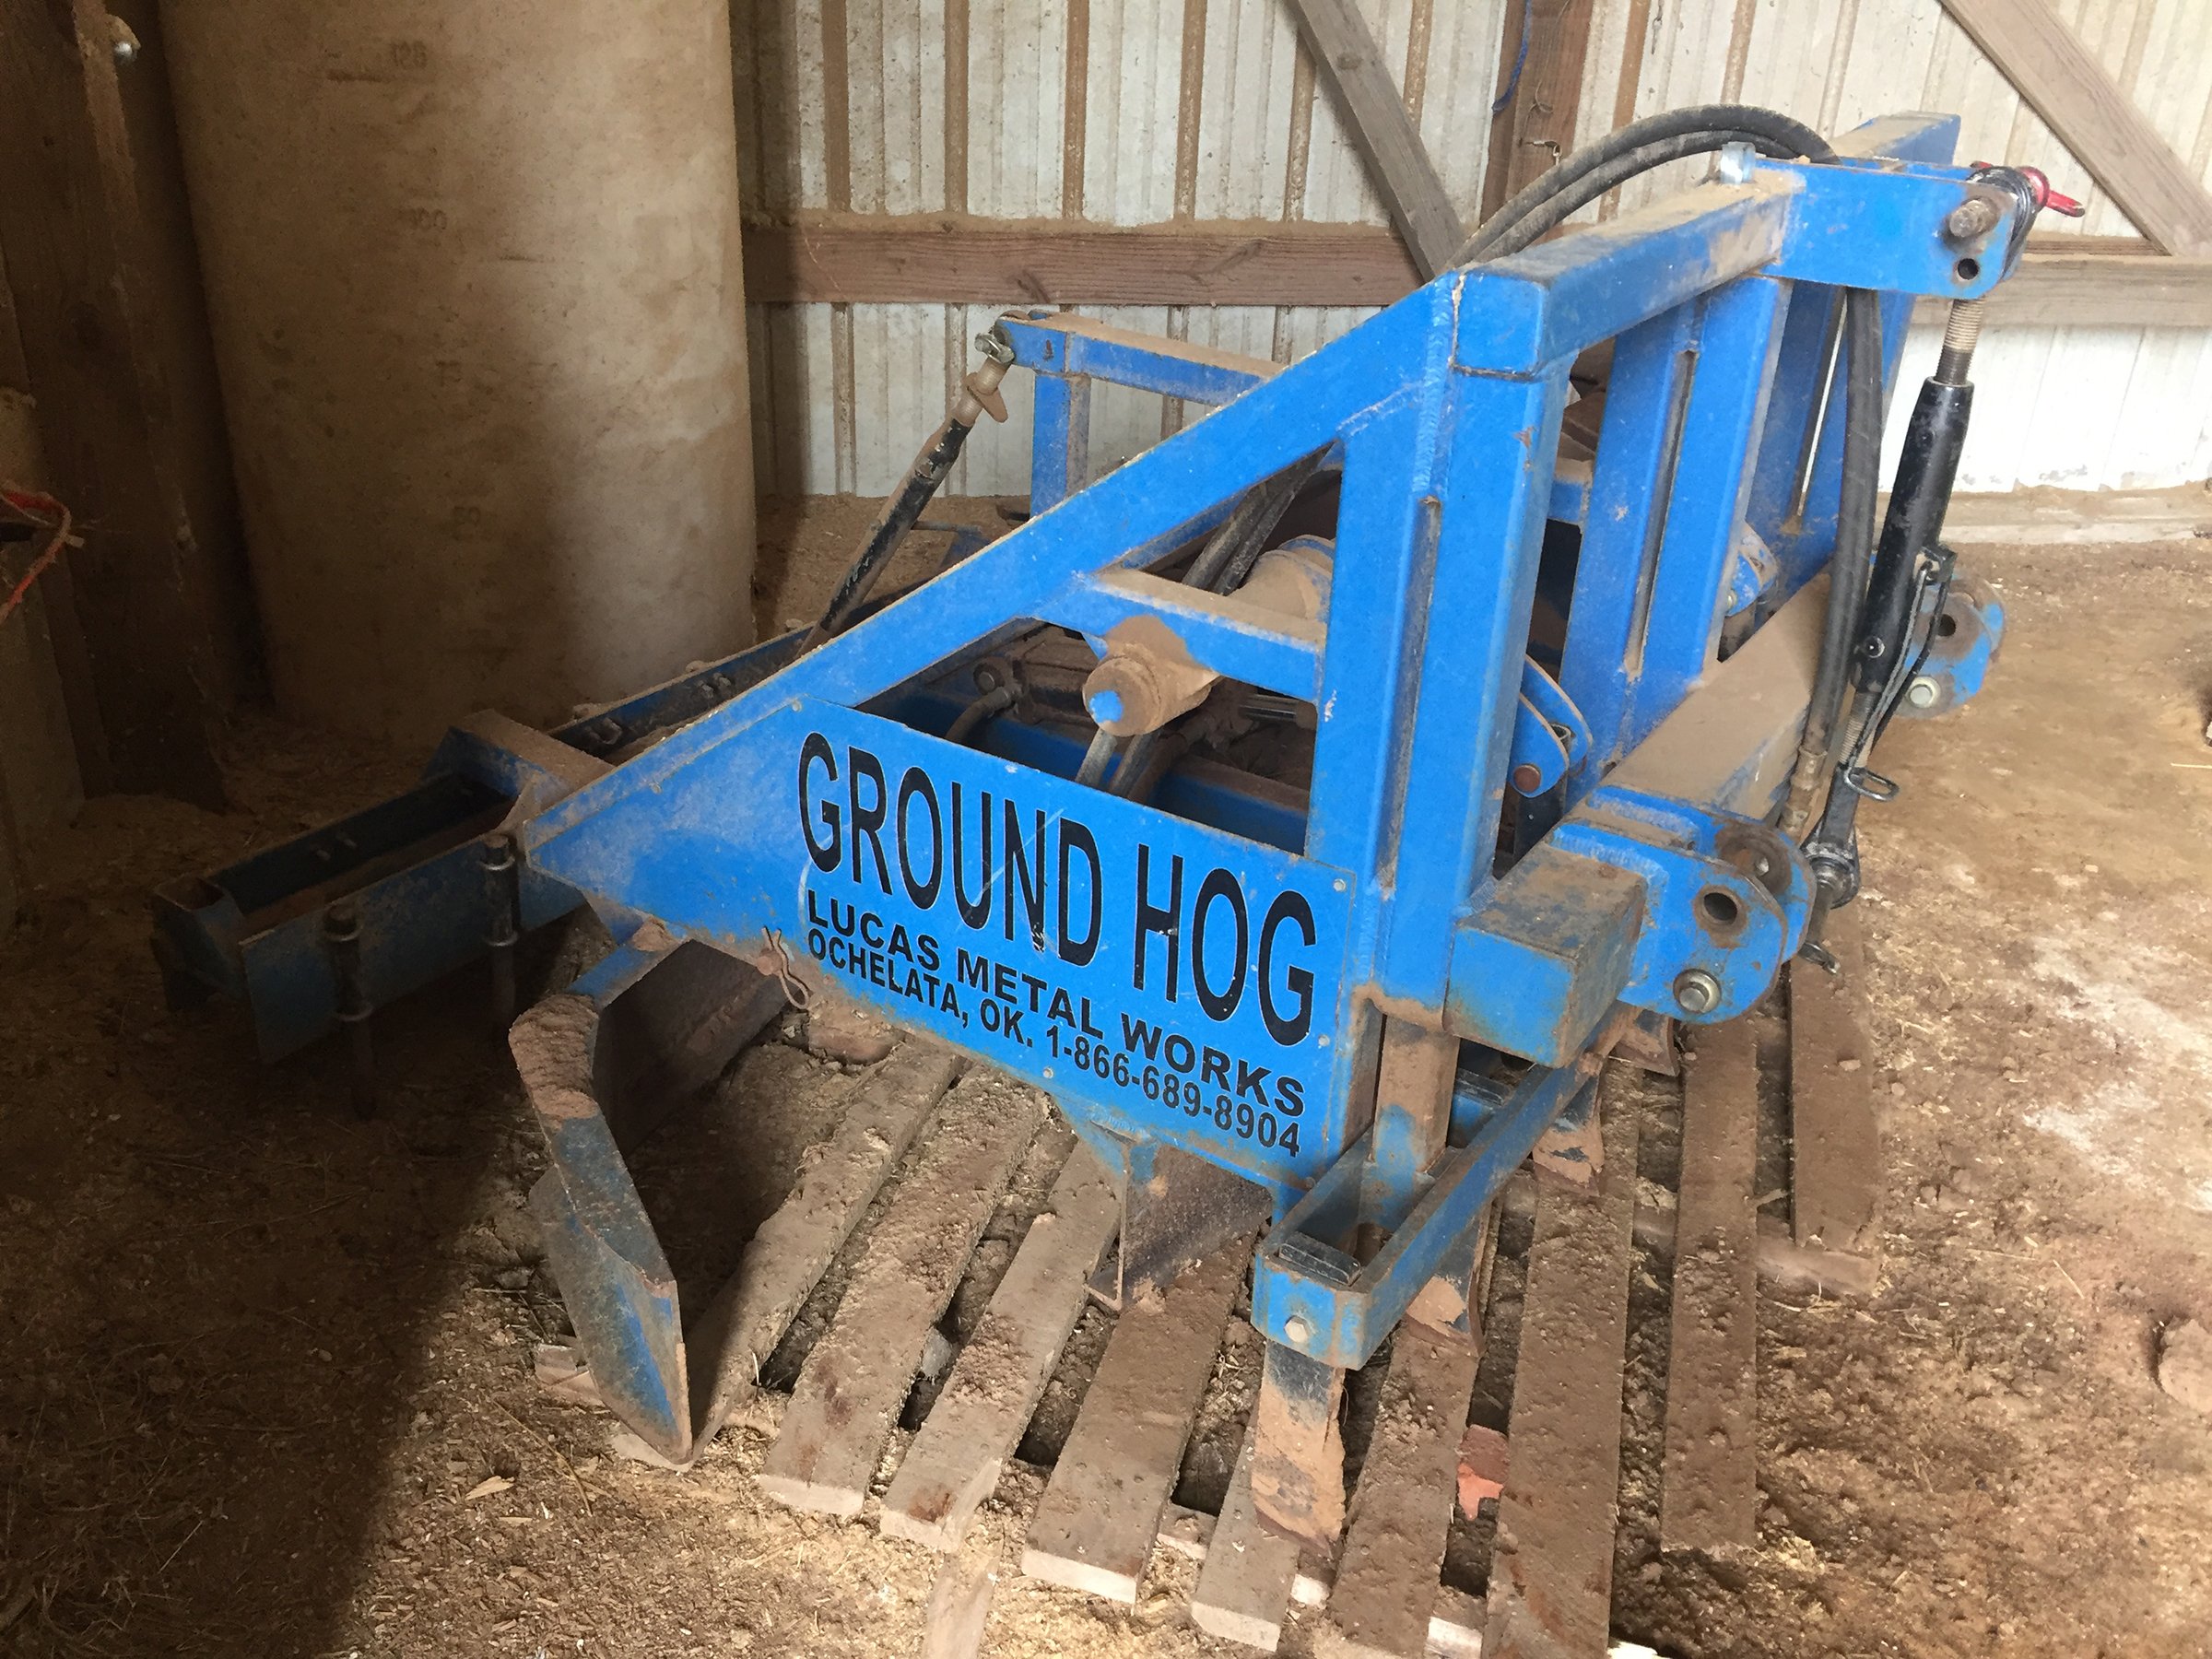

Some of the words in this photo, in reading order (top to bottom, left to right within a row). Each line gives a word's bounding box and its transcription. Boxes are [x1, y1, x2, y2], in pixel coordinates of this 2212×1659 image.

[799, 733, 1103, 967] GROUND
[1135, 845, 1317, 1046] HOG
[808, 889, 940, 971] LUCAS
[958, 947, 1103, 1039] METAL
[1121, 1013, 1304, 1116] WORKS
[808, 928, 968, 1028] OCHELATA,
[980, 998, 1032, 1047] OK.
[1046, 1025, 1300, 1157] 1-866-689-8904
